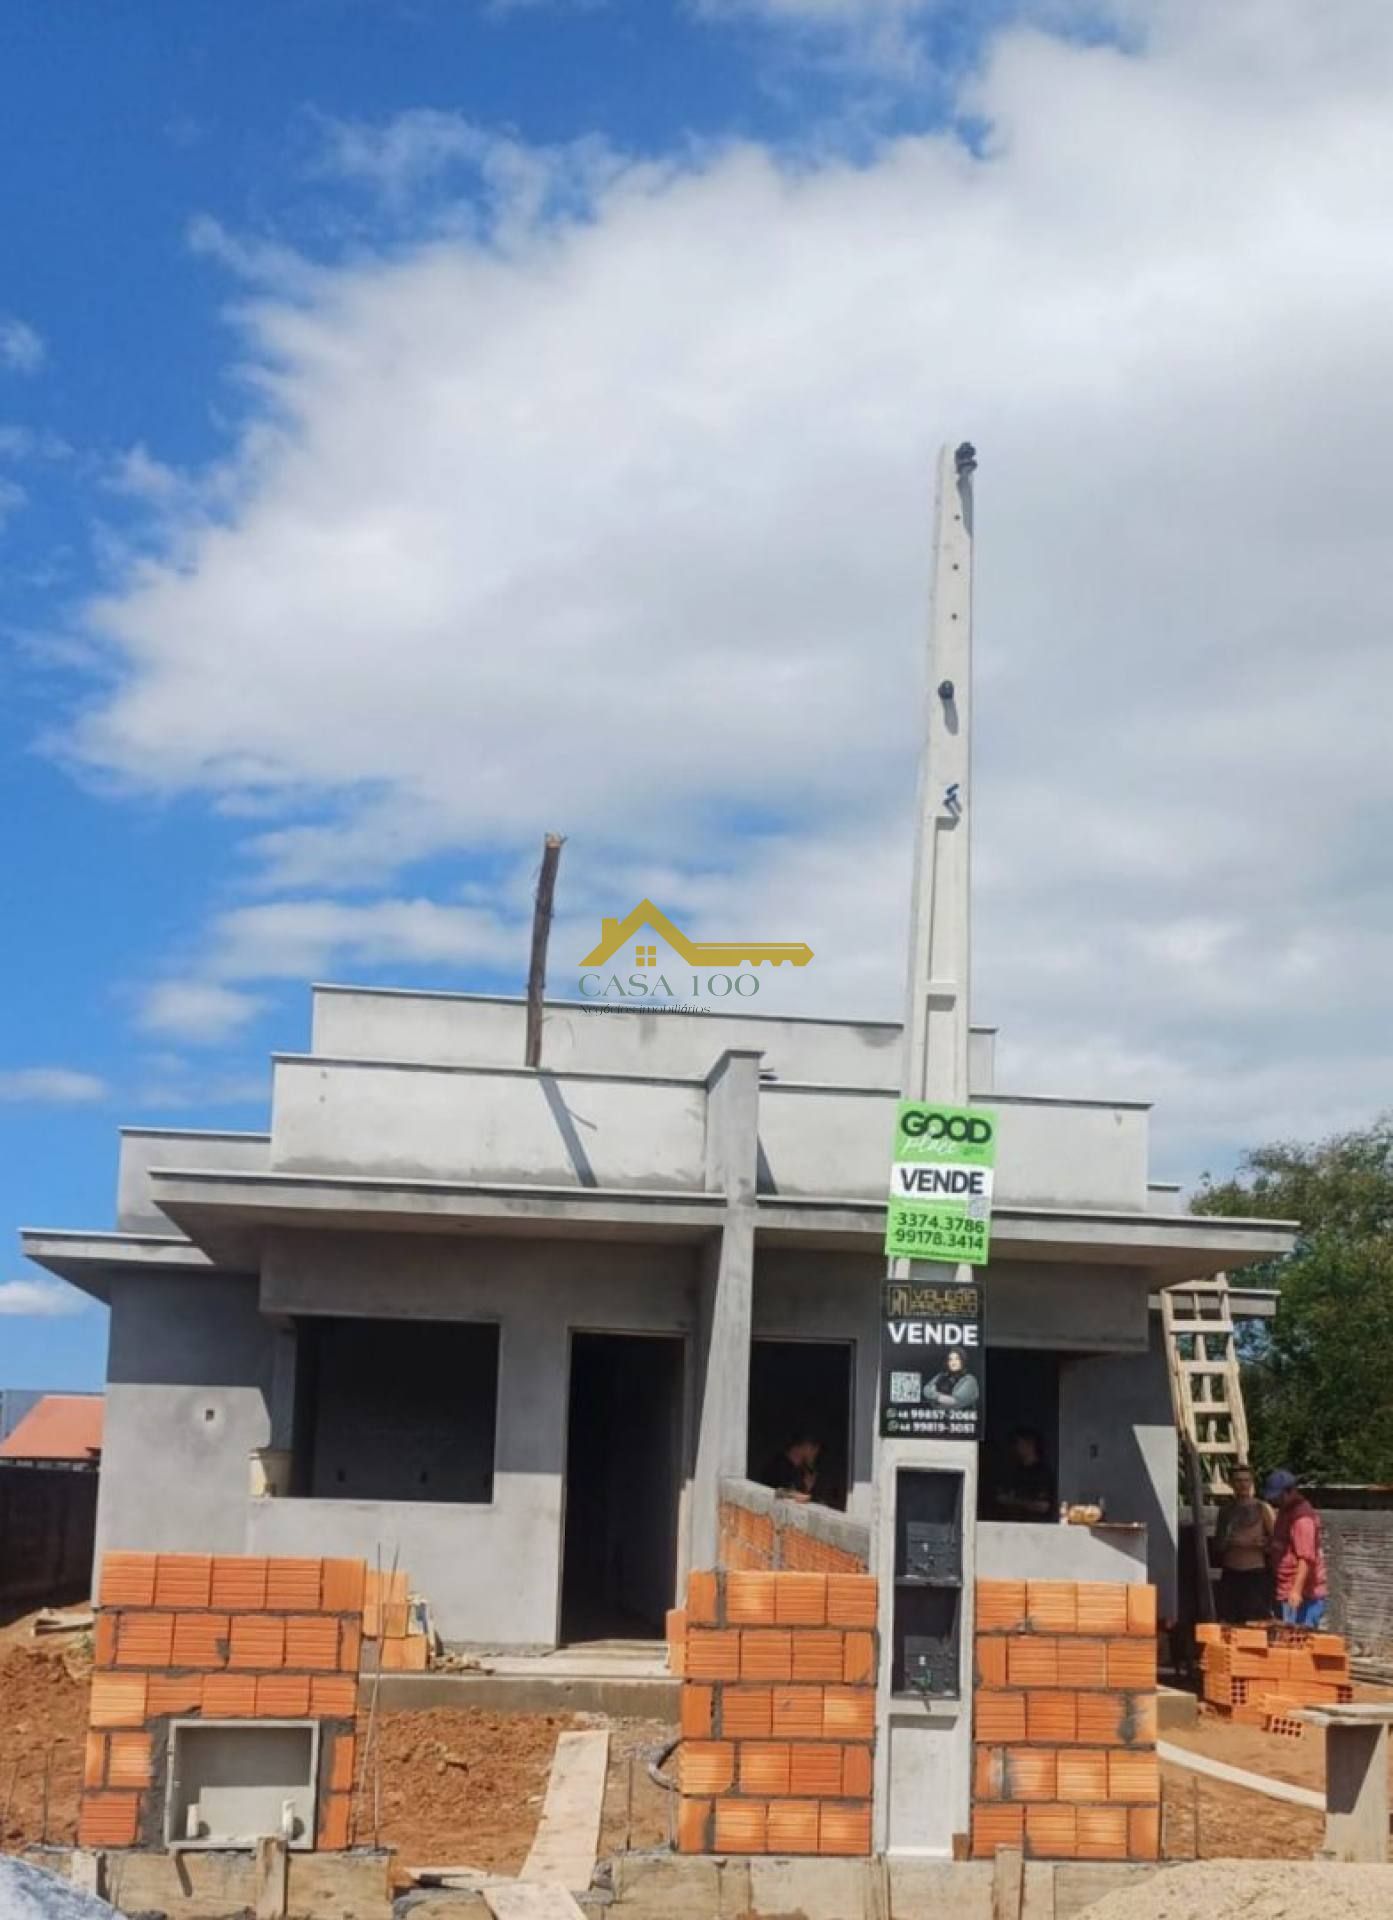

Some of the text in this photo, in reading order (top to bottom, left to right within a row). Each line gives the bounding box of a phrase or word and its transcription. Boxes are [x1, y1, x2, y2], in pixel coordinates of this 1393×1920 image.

[901, 1110, 992, 1144] GOOD
[900, 1167, 985, 1194] VENDE
[896, 1211, 985, 1234] 3374.3786
[887, 1322, 979, 1347] VENDE
